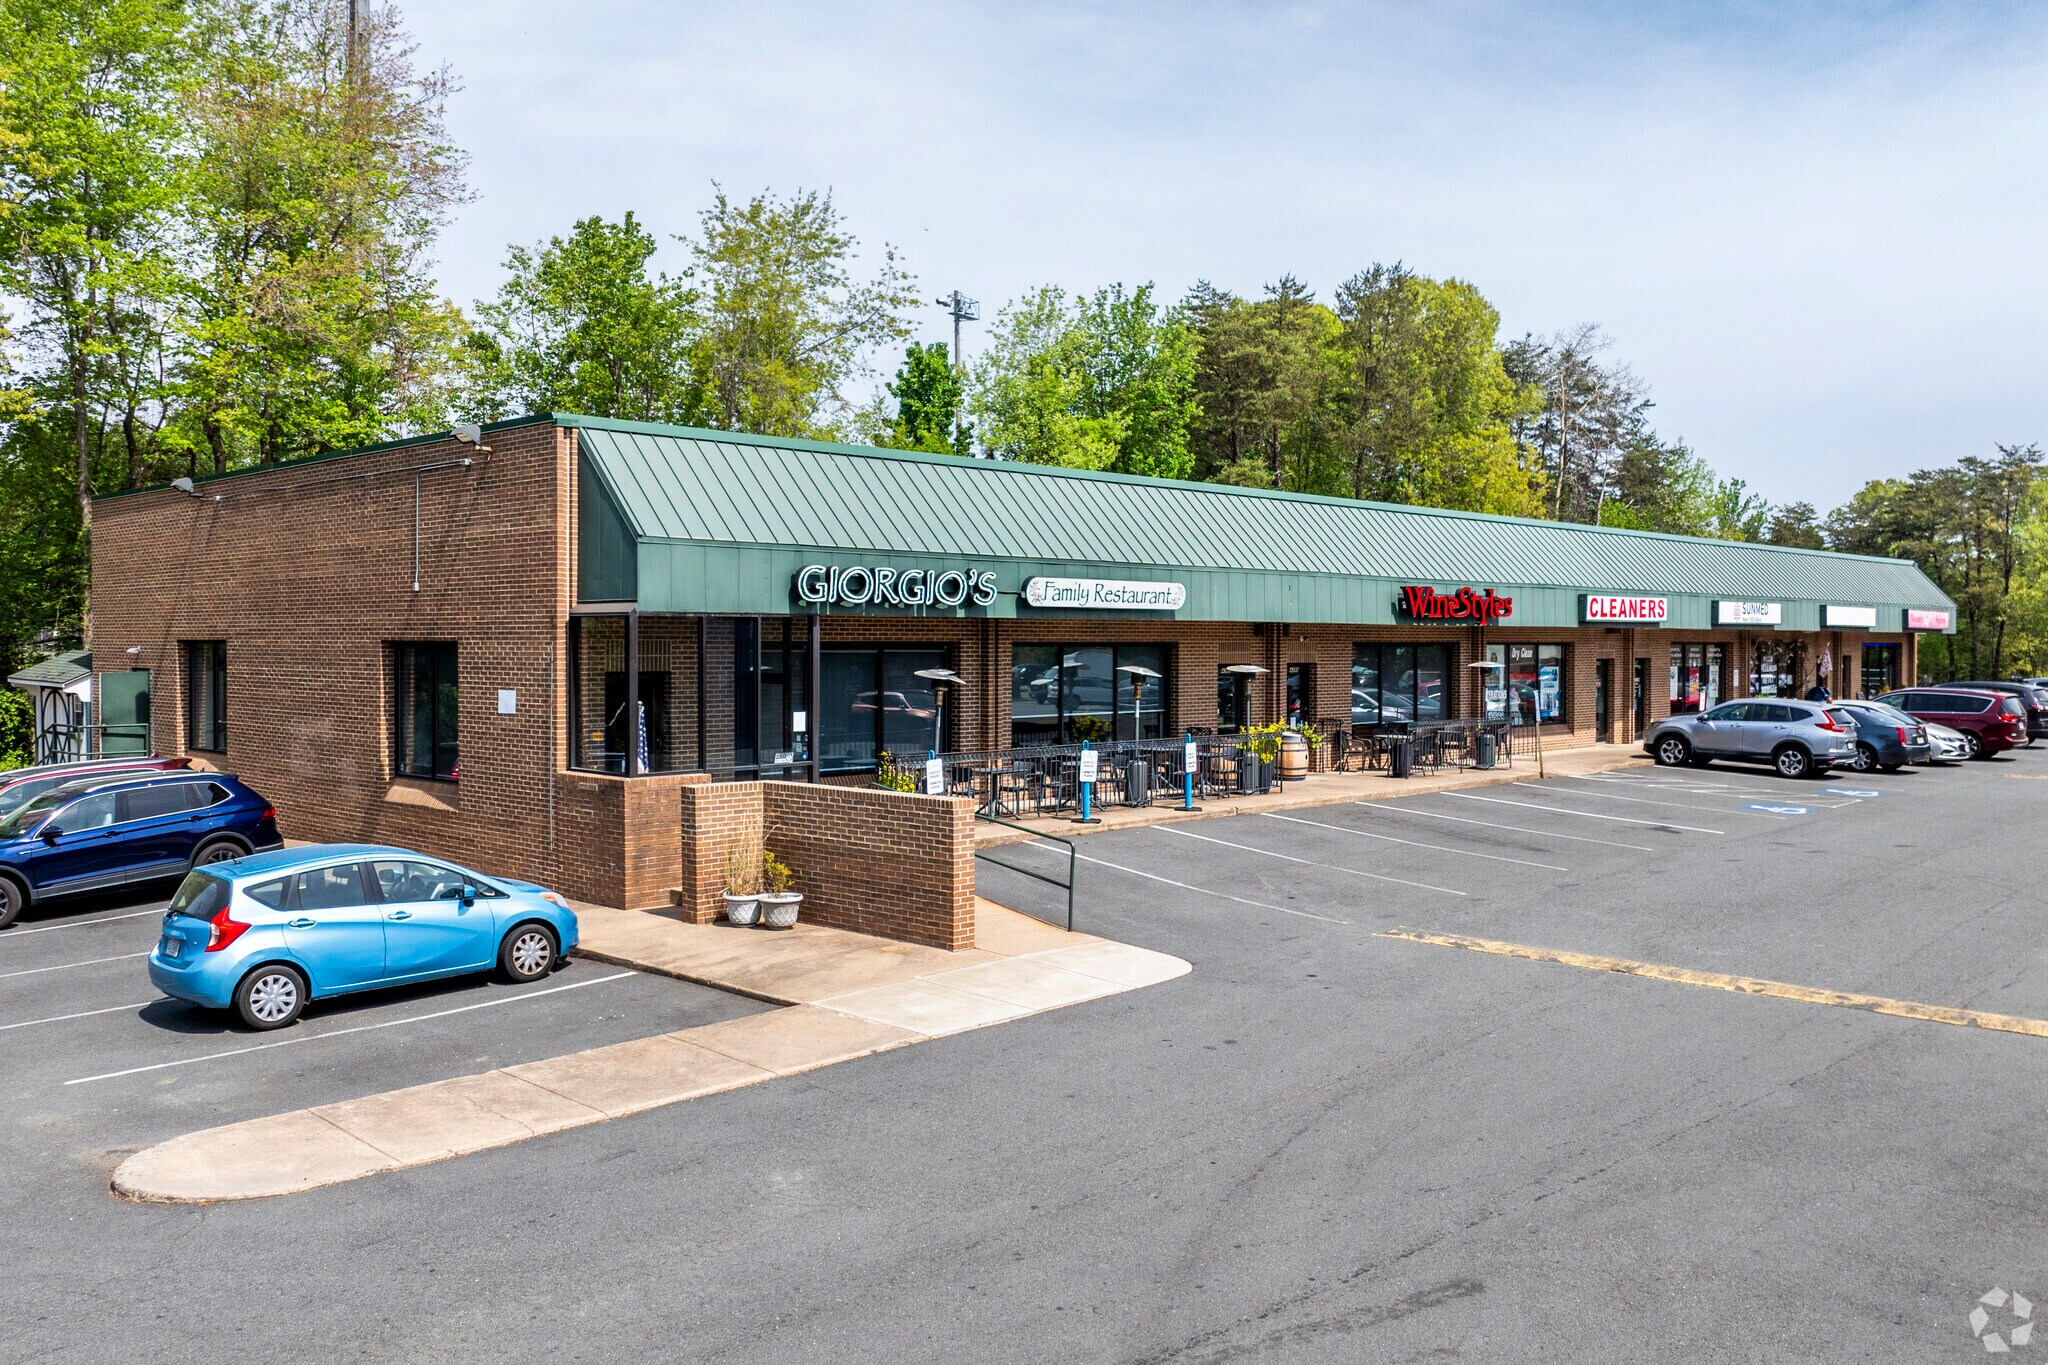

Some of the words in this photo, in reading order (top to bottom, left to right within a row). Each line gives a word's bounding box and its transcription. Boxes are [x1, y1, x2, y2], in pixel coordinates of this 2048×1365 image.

[797, 564, 998, 606] GIORGIO'S
[1041, 580, 1090, 607] Family
[1094, 583, 1172, 605] Restaurant
[1404, 585, 1513, 626] WineStyles
[1589, 597, 1665, 619] CLEANERS
[1742, 601, 1769, 616] SUNMED
[1511, 647, 1520, 661] Dry
[1520, 647, 1533, 659] Clean
[1486, 688, 1507, 700] ERATIONS
